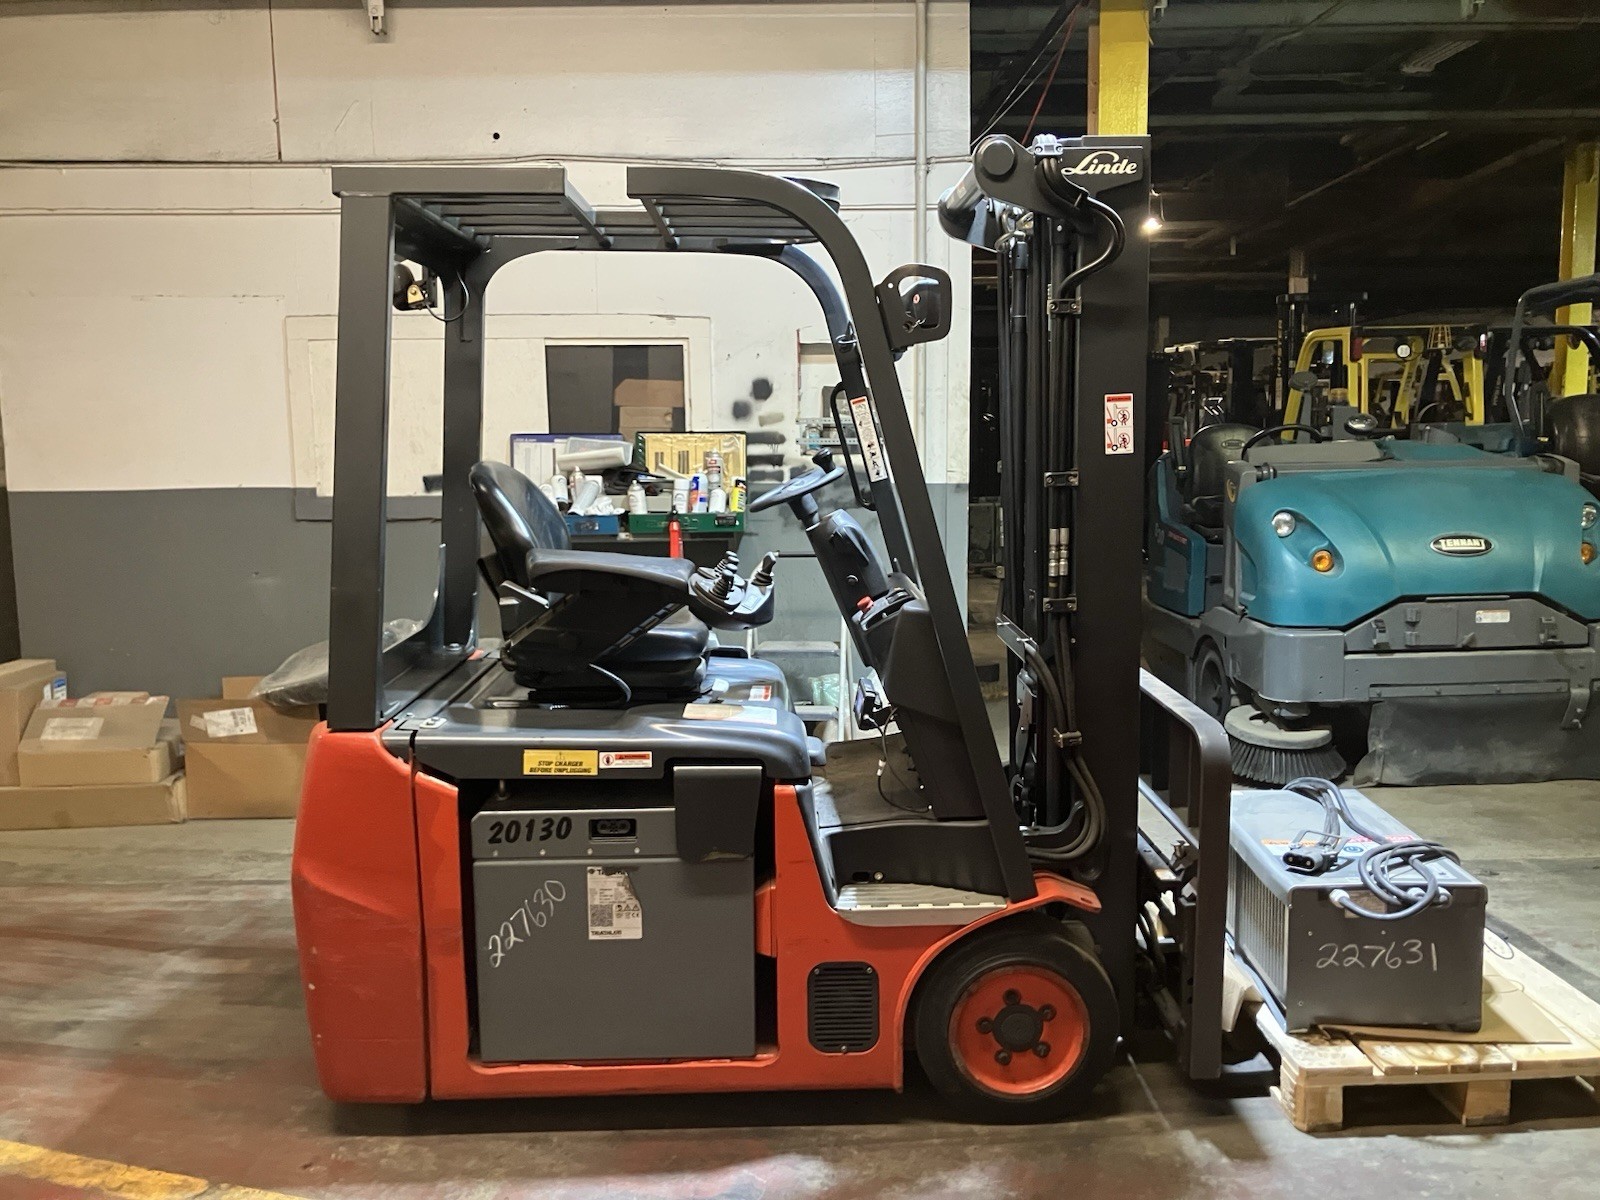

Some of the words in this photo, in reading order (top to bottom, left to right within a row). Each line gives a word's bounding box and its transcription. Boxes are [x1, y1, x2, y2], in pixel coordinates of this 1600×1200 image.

[1061, 151, 1137, 175] Linde
[1439, 538, 1486, 550] TENNANT
[488, 816, 572, 844] 20130
[488, 880, 566, 968] 227630
[1316, 939, 1437, 971] 227631
